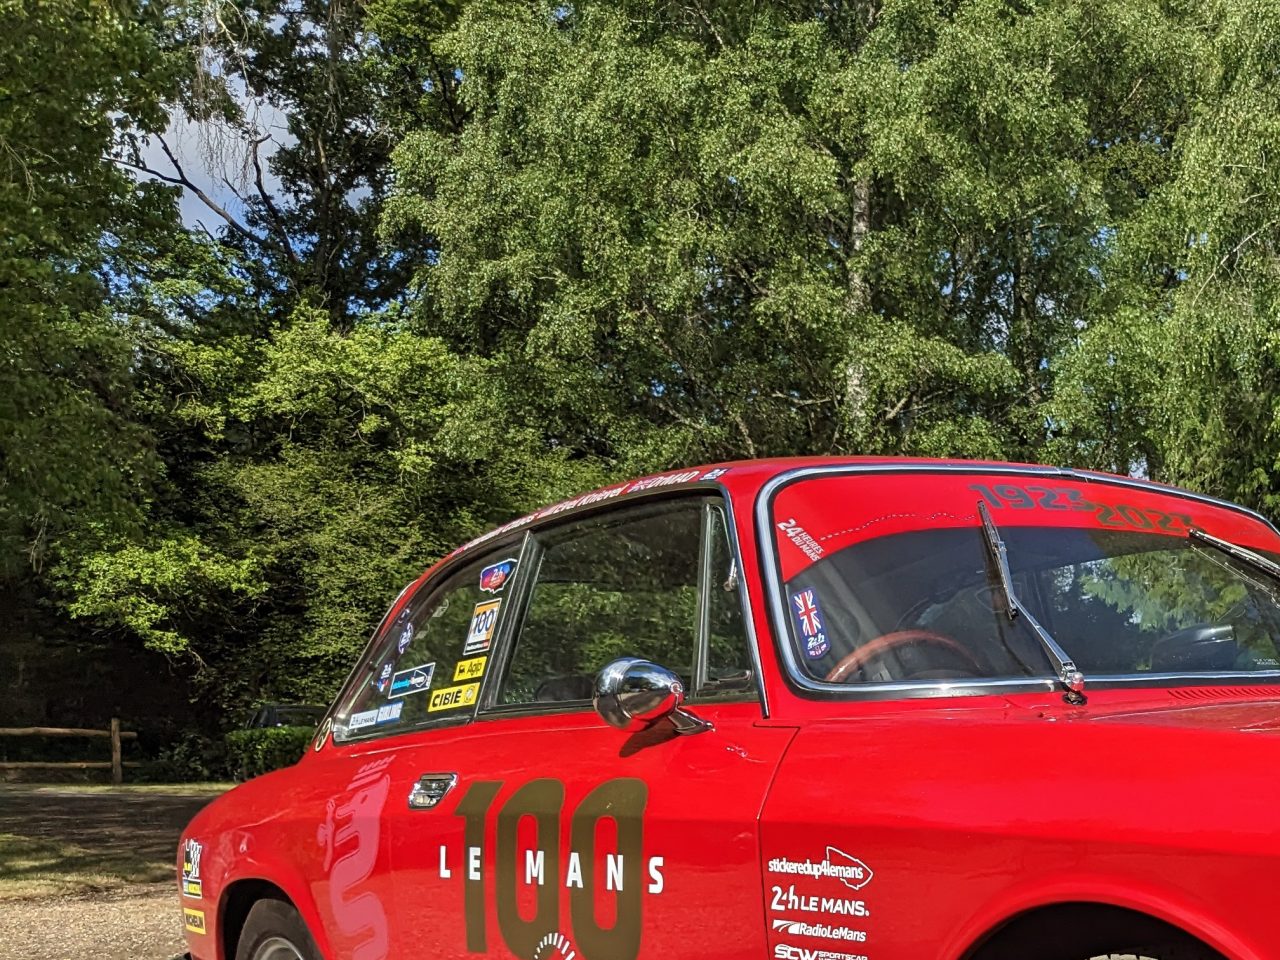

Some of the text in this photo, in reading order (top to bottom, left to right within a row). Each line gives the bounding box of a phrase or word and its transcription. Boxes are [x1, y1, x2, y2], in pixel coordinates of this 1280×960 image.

[777, 518, 804, 537] 24
[473, 608, 496, 635] 100
[467, 660, 483, 676] Agip
[439, 845, 665, 894] LE MANS
[768, 857, 864, 879] stickeredup4lemans
[800, 896, 819, 912] LE
[799, 922, 867, 942] RadioLeMans
